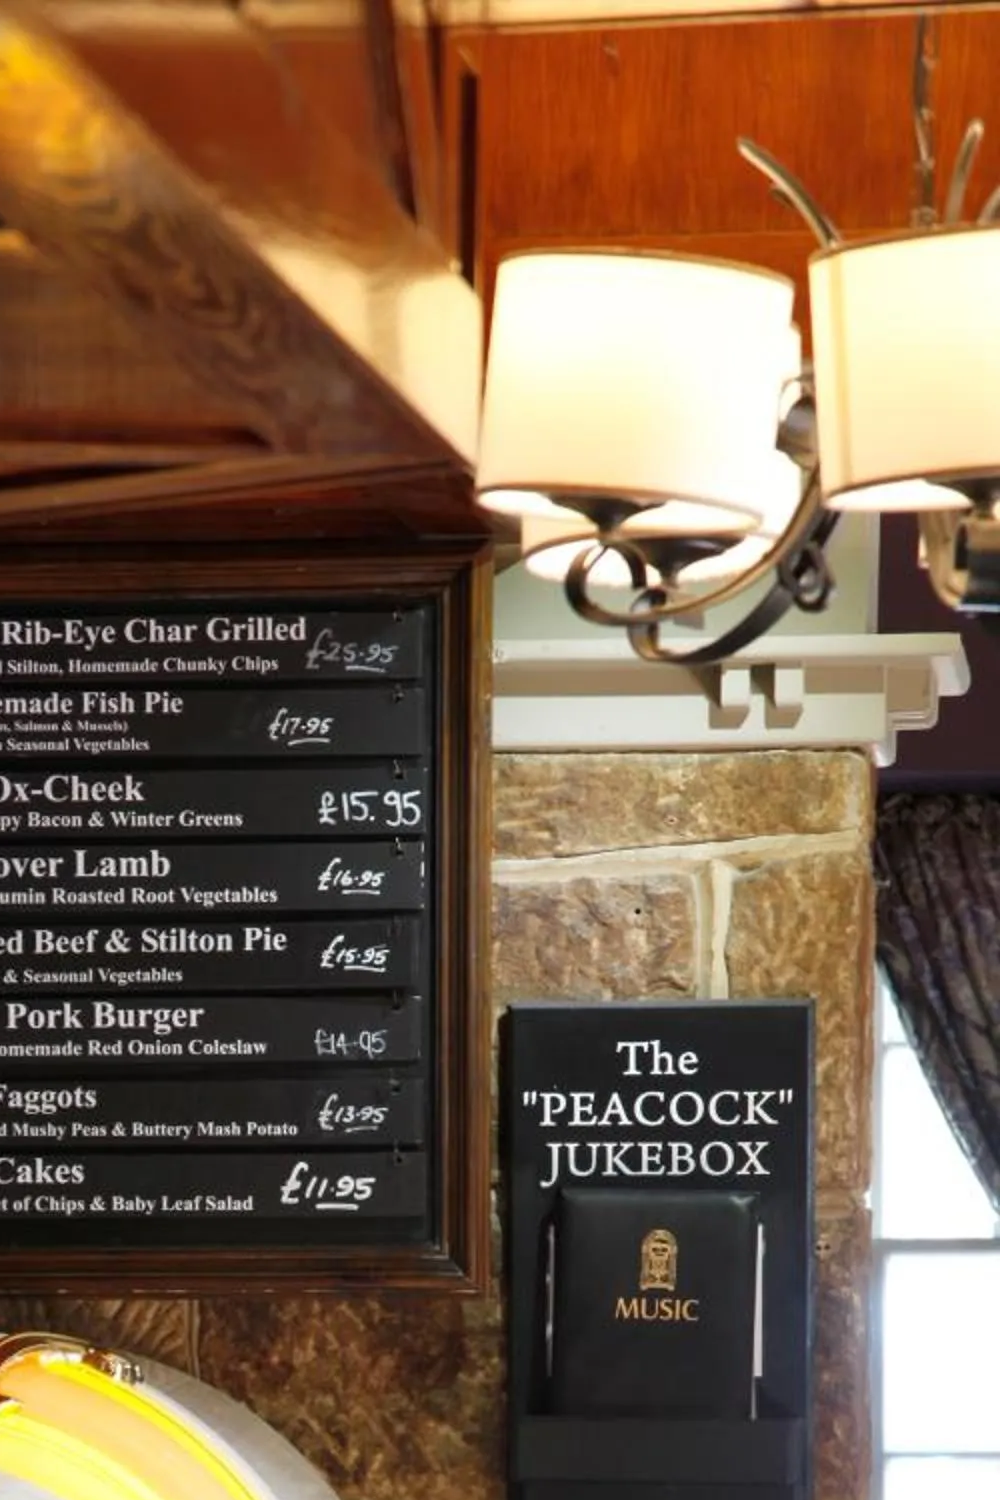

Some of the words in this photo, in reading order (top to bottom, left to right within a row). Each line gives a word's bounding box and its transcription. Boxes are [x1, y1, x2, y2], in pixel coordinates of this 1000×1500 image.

[1, 620, 116, 650] Rib-Eye
[123, 618, 199, 643] Char
[205, 616, 307, 642] Grilled
[305, 628, 399, 669] £25.95
[6, 660, 64, 674] Stilton,
[68, 658, 159, 673] Homemade
[162, 657, 227, 675] Chunky
[231, 656, 280, 674] Chips
[82, 692, 135, 714] Fish
[144, 692, 184, 713] Pie
[27, 812, 83, 827] Bacon
[87, 811, 105, 827] &
[109, 811, 175, 827] Winter
[178, 810, 244, 827] Greens
[318, 791, 421, 826] £15.95
[74, 850, 171, 877] Lamb
[317, 857, 385, 891] £16.95
[51, 888, 126, 904] Roasted
[131, 888, 176, 904] Root
[179, 886, 279, 907] Vegetables
[34, 929, 100, 954] Beef
[104, 929, 131, 953] &
[140, 928, 233, 952] Stilton
[243, 927, 288, 951] Pie
[320, 934, 390, 969] £15.95
[2, 969, 19, 983] &
[23, 968, 94, 983] Seasonal
[97, 968, 184, 986] Vegetables
[6, 1002, 84, 1029] Pork
[92, 1002, 205, 1035] Burger
[87, 1040, 123, 1055] Red
[127, 1040, 184, 1055] Onion
[187, 1039, 268, 1055] Coleslaw
[615, 1040, 699, 1075] The
[318, 1093, 389, 1131] £13.95
[523, 1089, 793, 1127] "PEACOCK"
[12, 1123, 67, 1140] Mushy
[71, 1122, 108, 1136] Peas
[110, 1122, 127, 1136] &
[131, 1122, 193, 1140] Buttery
[197, 1122, 242, 1136] Mash
[246, 1122, 299, 1136] Potato
[539, 1141, 770, 1187] JUKEBOX
[280, 1161, 376, 1203] £11.95
[12, 1196, 33, 1211] of
[34, 1196, 87, 1215] Chips
[88, 1196, 108, 1211] &
[110, 1196, 158, 1214] Baby
[159, 1195, 203, 1211] Leaf
[205, 1195, 255, 1211] Salad
[615, 1297, 700, 1321] MUSIC
